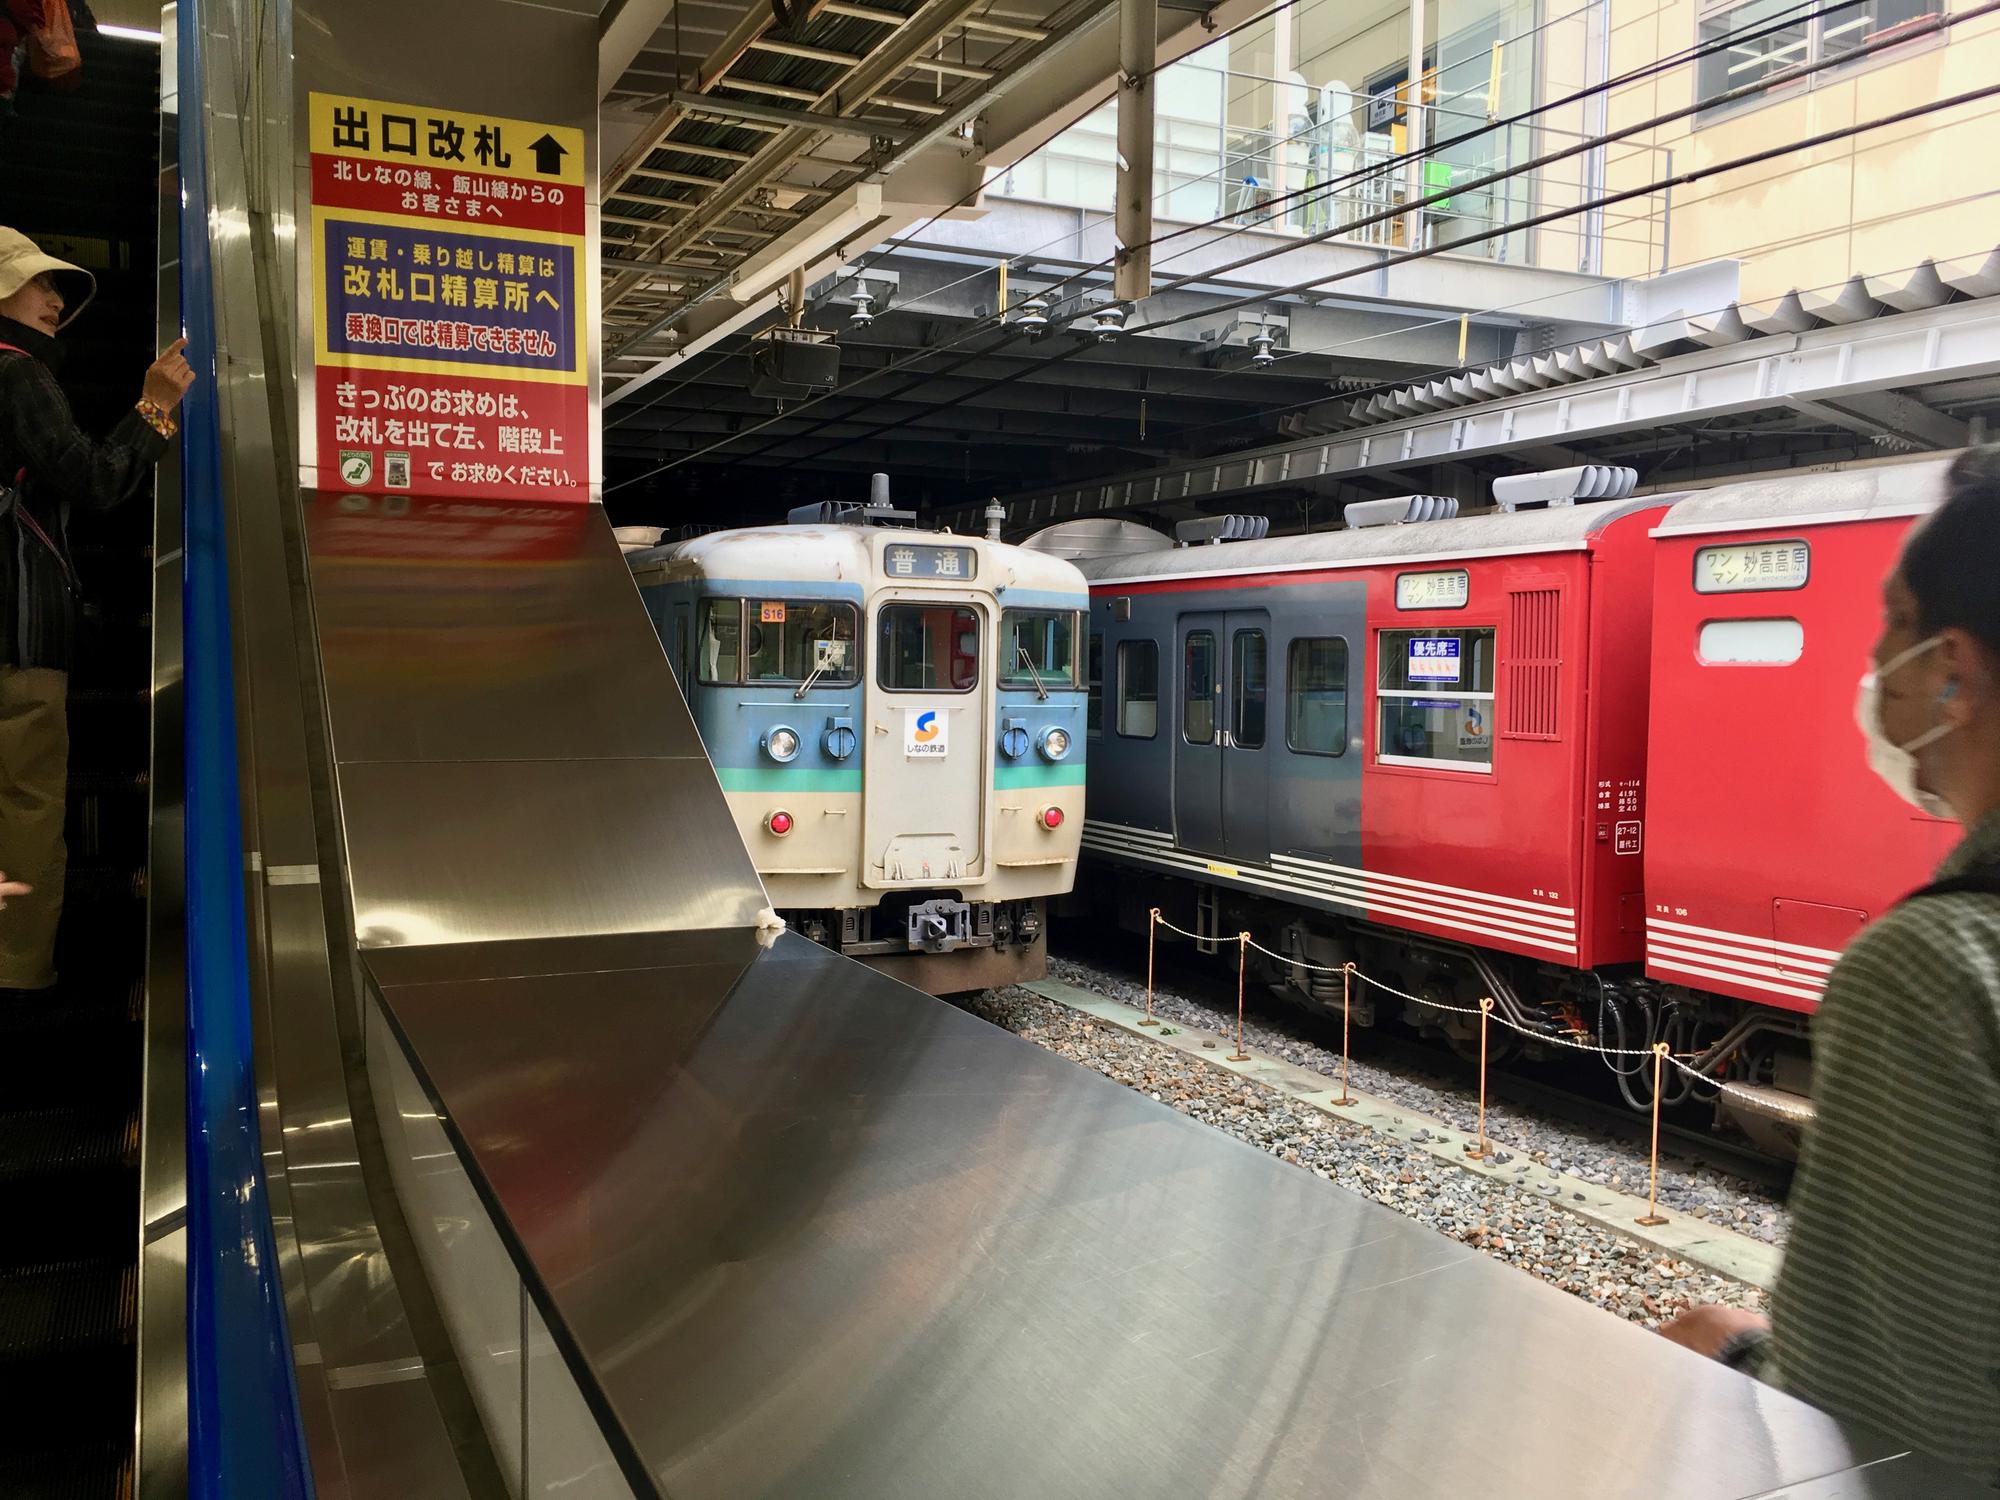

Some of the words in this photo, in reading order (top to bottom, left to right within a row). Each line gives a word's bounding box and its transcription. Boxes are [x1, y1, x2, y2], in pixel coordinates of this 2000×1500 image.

[333, 106, 511, 169] 出口改札
[333, 160, 564, 206] 北しなの線、飯山線からの
[401, 190, 503, 218] お客さまへ
[347, 236, 554, 278] 運賃・乗り越し精算は
[343, 264, 560, 313] 改札口精算所へ
[345, 312, 557, 357] 乗換口では精算できません
[335, 382, 529, 420] きっぷのお求めは、
[335, 415, 564, 456] 改札を出て左、階段上
[891, 549, 960, 576] 普通
[1744, 547, 1806, 574] 妙高高原
[763, 609, 783, 619] S16
[1414, 641, 1448, 656] 優先席
[907, 744, 945, 753] しなの鉄道
